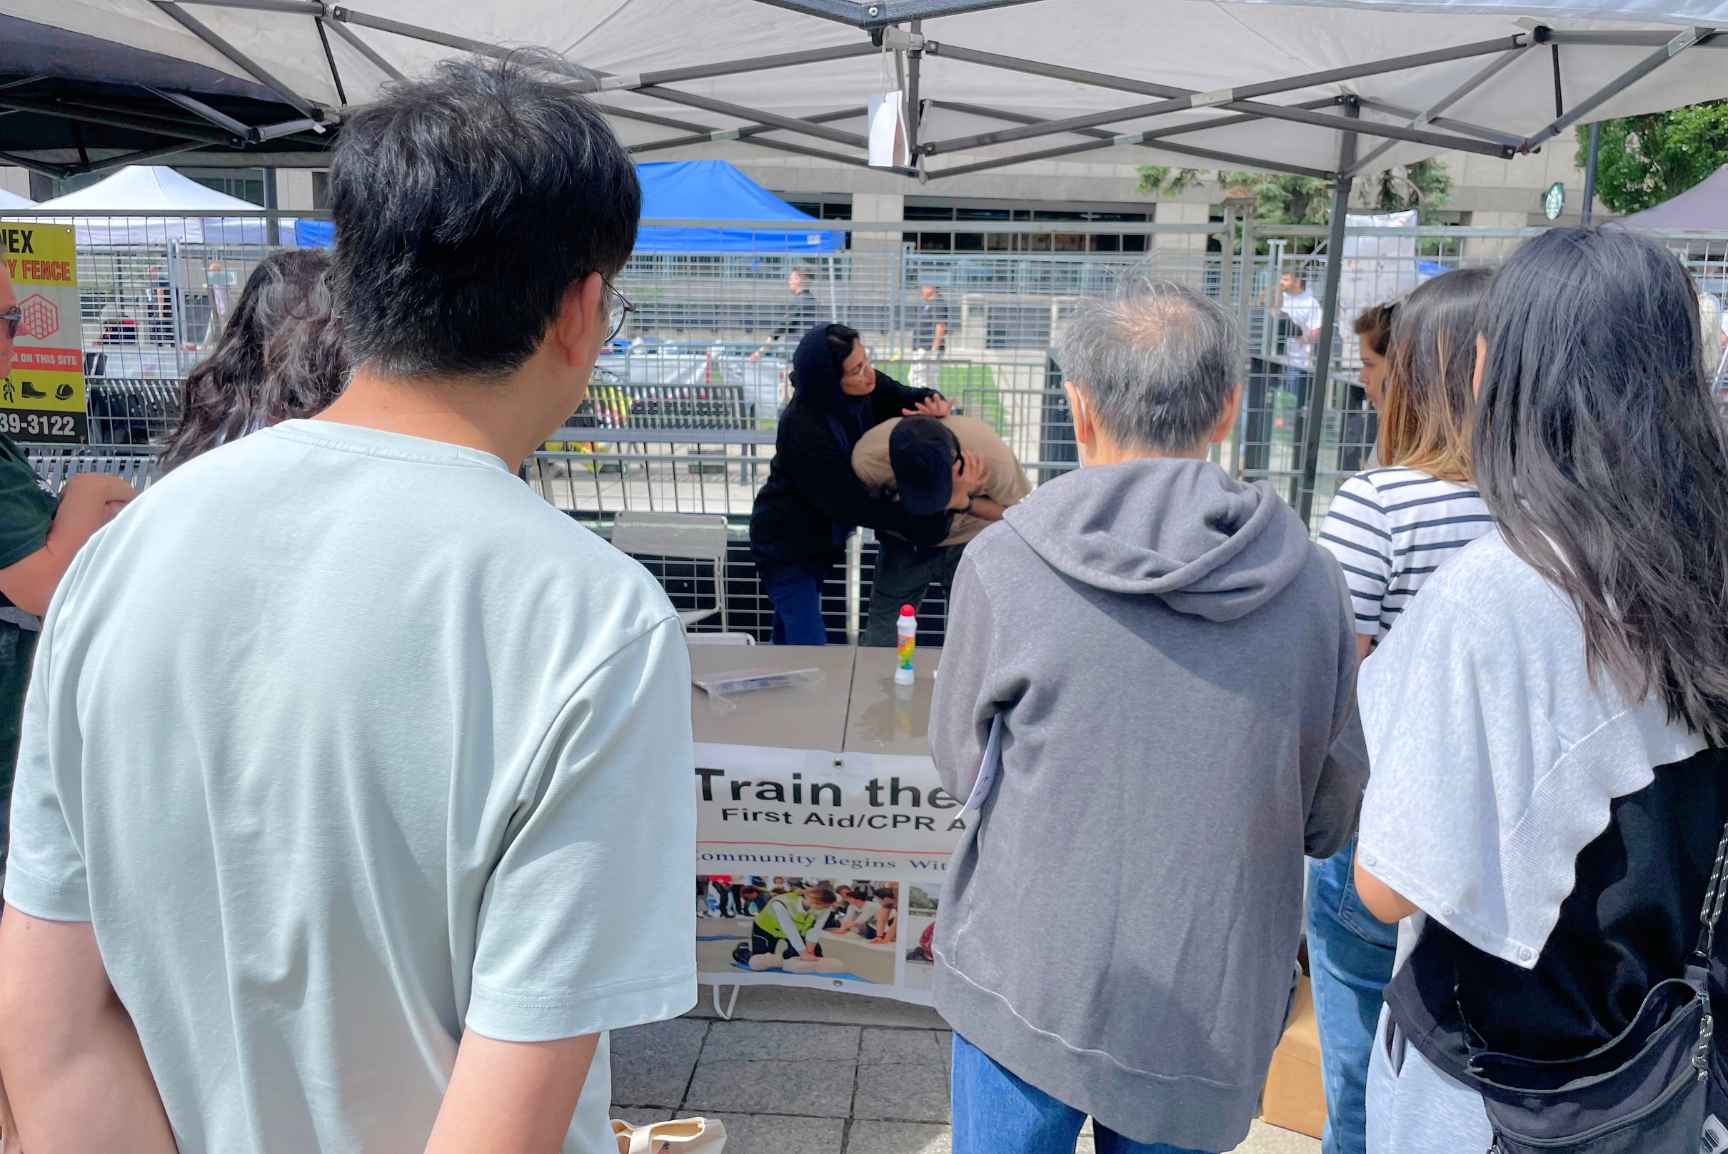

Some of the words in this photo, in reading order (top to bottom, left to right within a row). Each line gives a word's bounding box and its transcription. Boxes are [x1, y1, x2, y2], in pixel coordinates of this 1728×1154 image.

[22, 260, 72, 281] FENCE
[21, 353, 33, 363] ON
[35, 354, 55, 366] THIS
[57, 355, 77, 367] SITE
[695, 768, 841, 807] Train
[865, 777, 958, 809] the
[722, 808, 793, 825] First
[803, 812, 936, 831] Aid/CPR
[946, 818, 967, 831] A
[697, 853, 815, 867] ommunity
[824, 855, 896, 869] Begins
[909, 860, 948, 871] Wit
